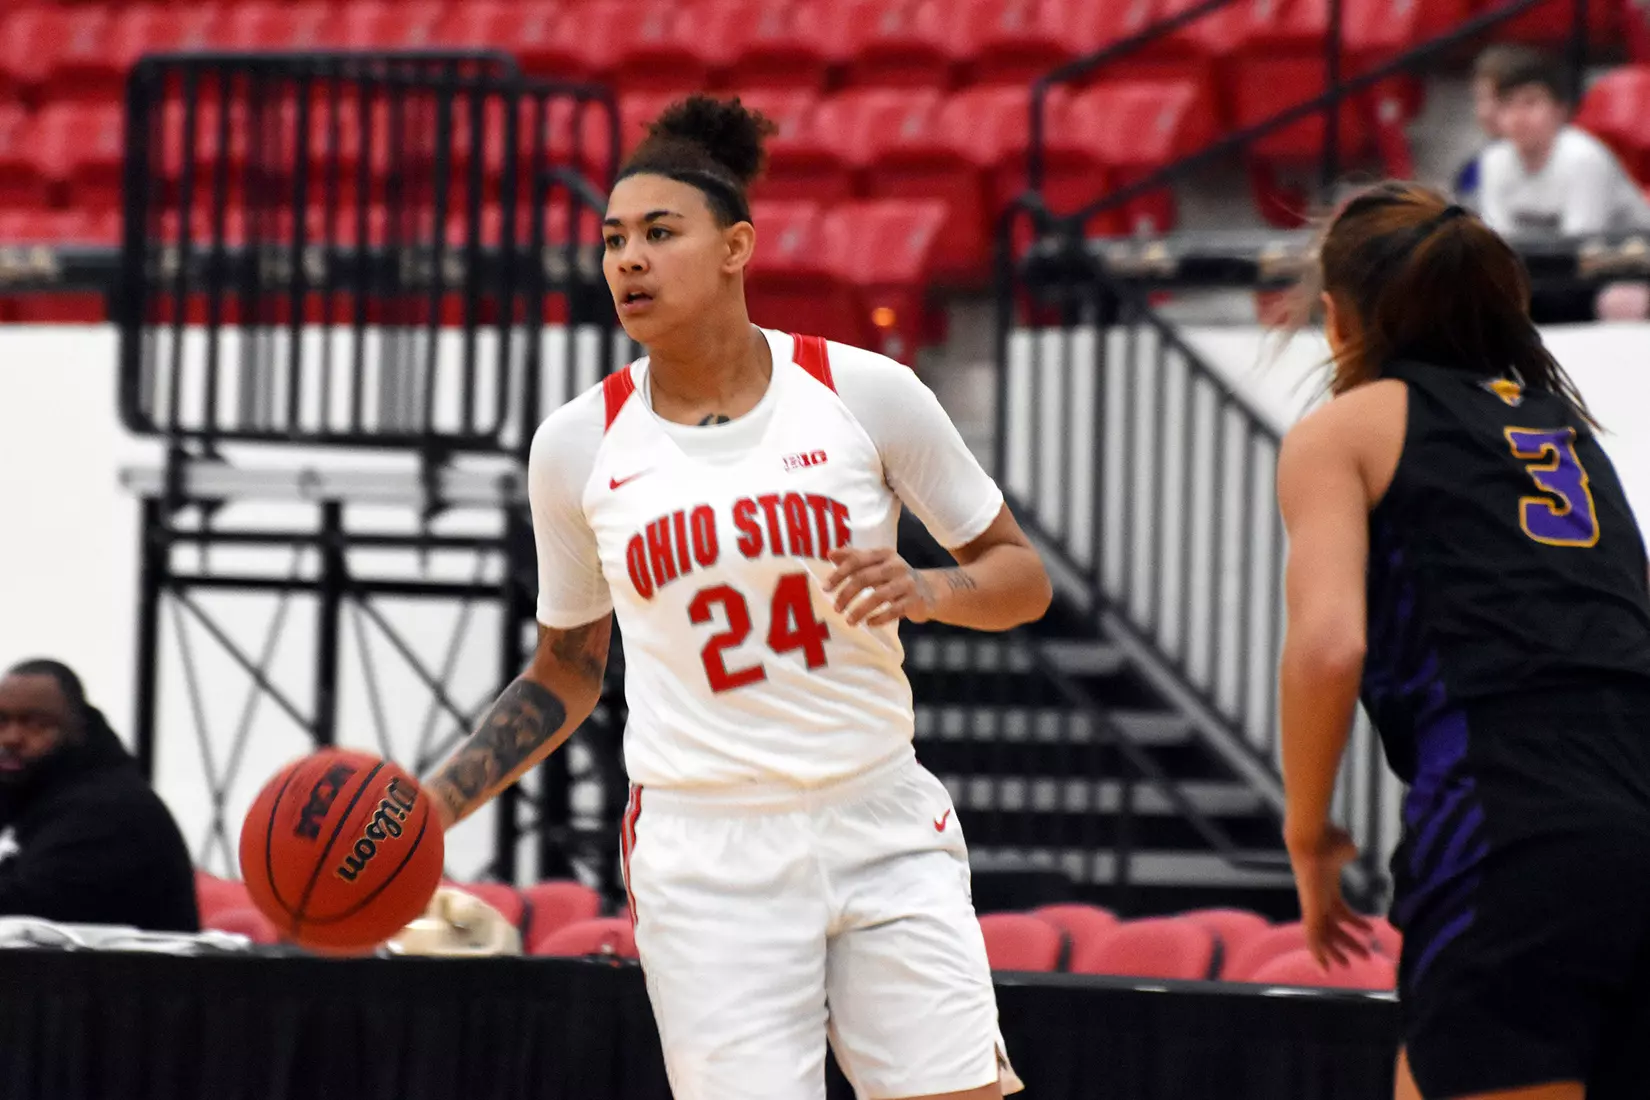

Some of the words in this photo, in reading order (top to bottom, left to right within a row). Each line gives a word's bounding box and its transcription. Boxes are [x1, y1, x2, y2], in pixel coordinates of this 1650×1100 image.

[1503, 426, 1600, 548] 3
[626, 503, 719, 600] OHIO
[732, 491, 851, 561] STATE
[687, 572, 830, 693] 24
[334, 776, 419, 882] Wilson
